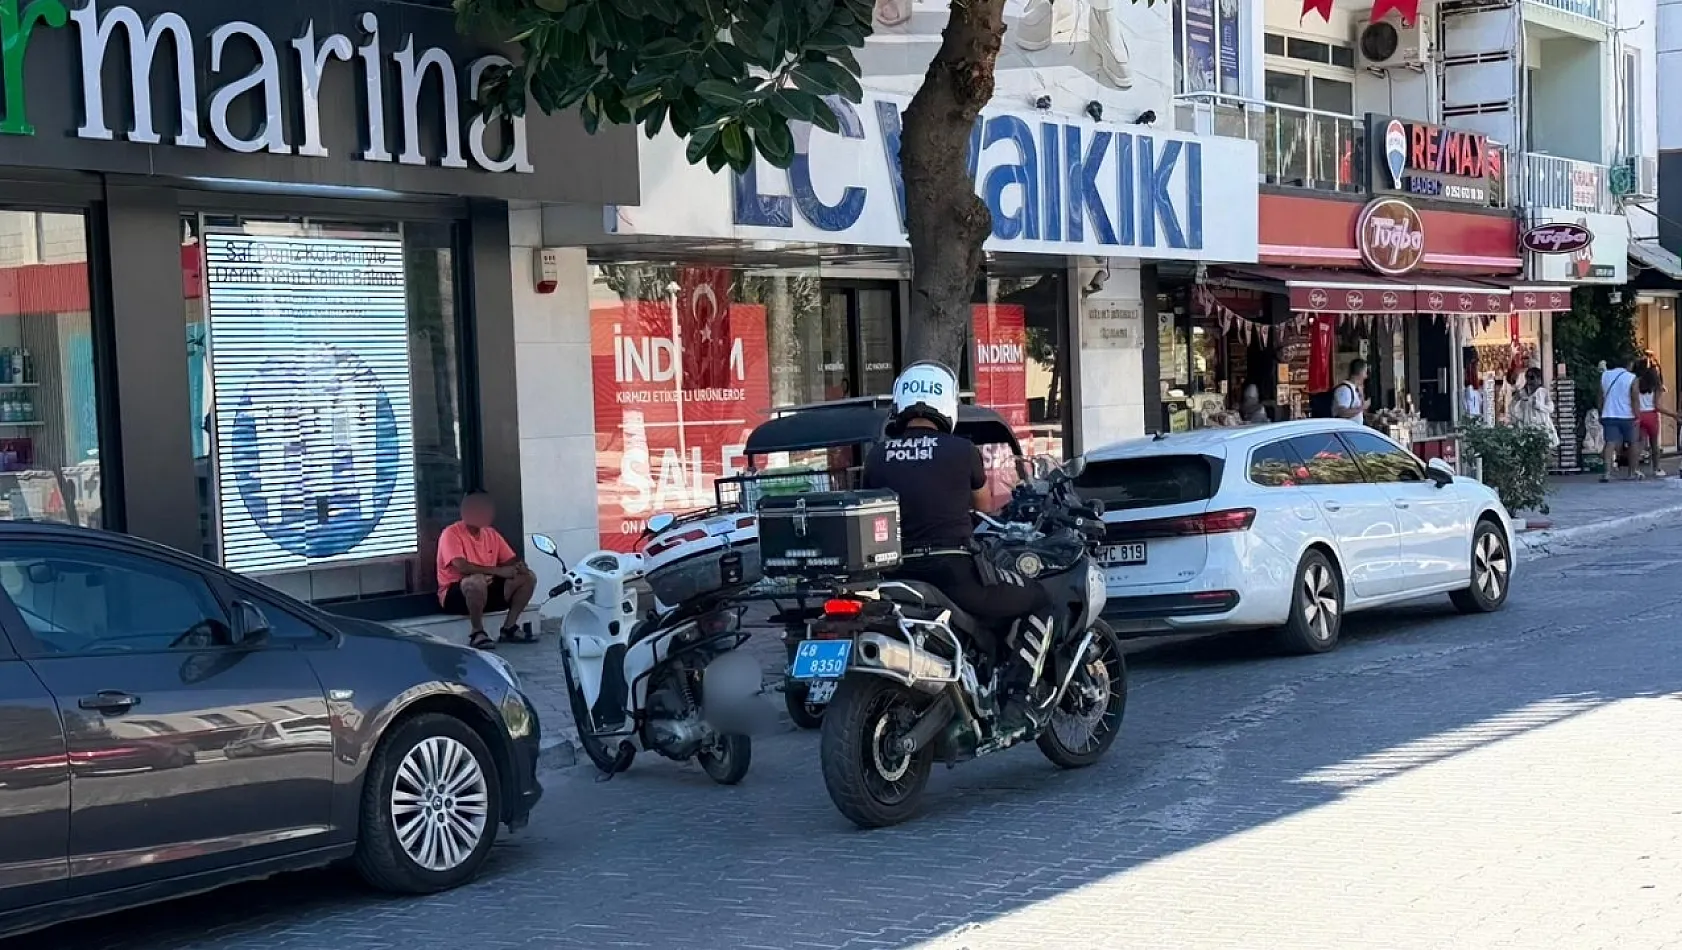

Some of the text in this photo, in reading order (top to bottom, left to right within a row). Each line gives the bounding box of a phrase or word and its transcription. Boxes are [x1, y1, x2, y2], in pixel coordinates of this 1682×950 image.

[1411, 125, 1486, 178] RE/MAX
[621, 520, 638, 535] ON
[1121, 544, 1142, 561] 819
[800, 644, 817, 657] 48
[810, 659, 842, 673] 8350
